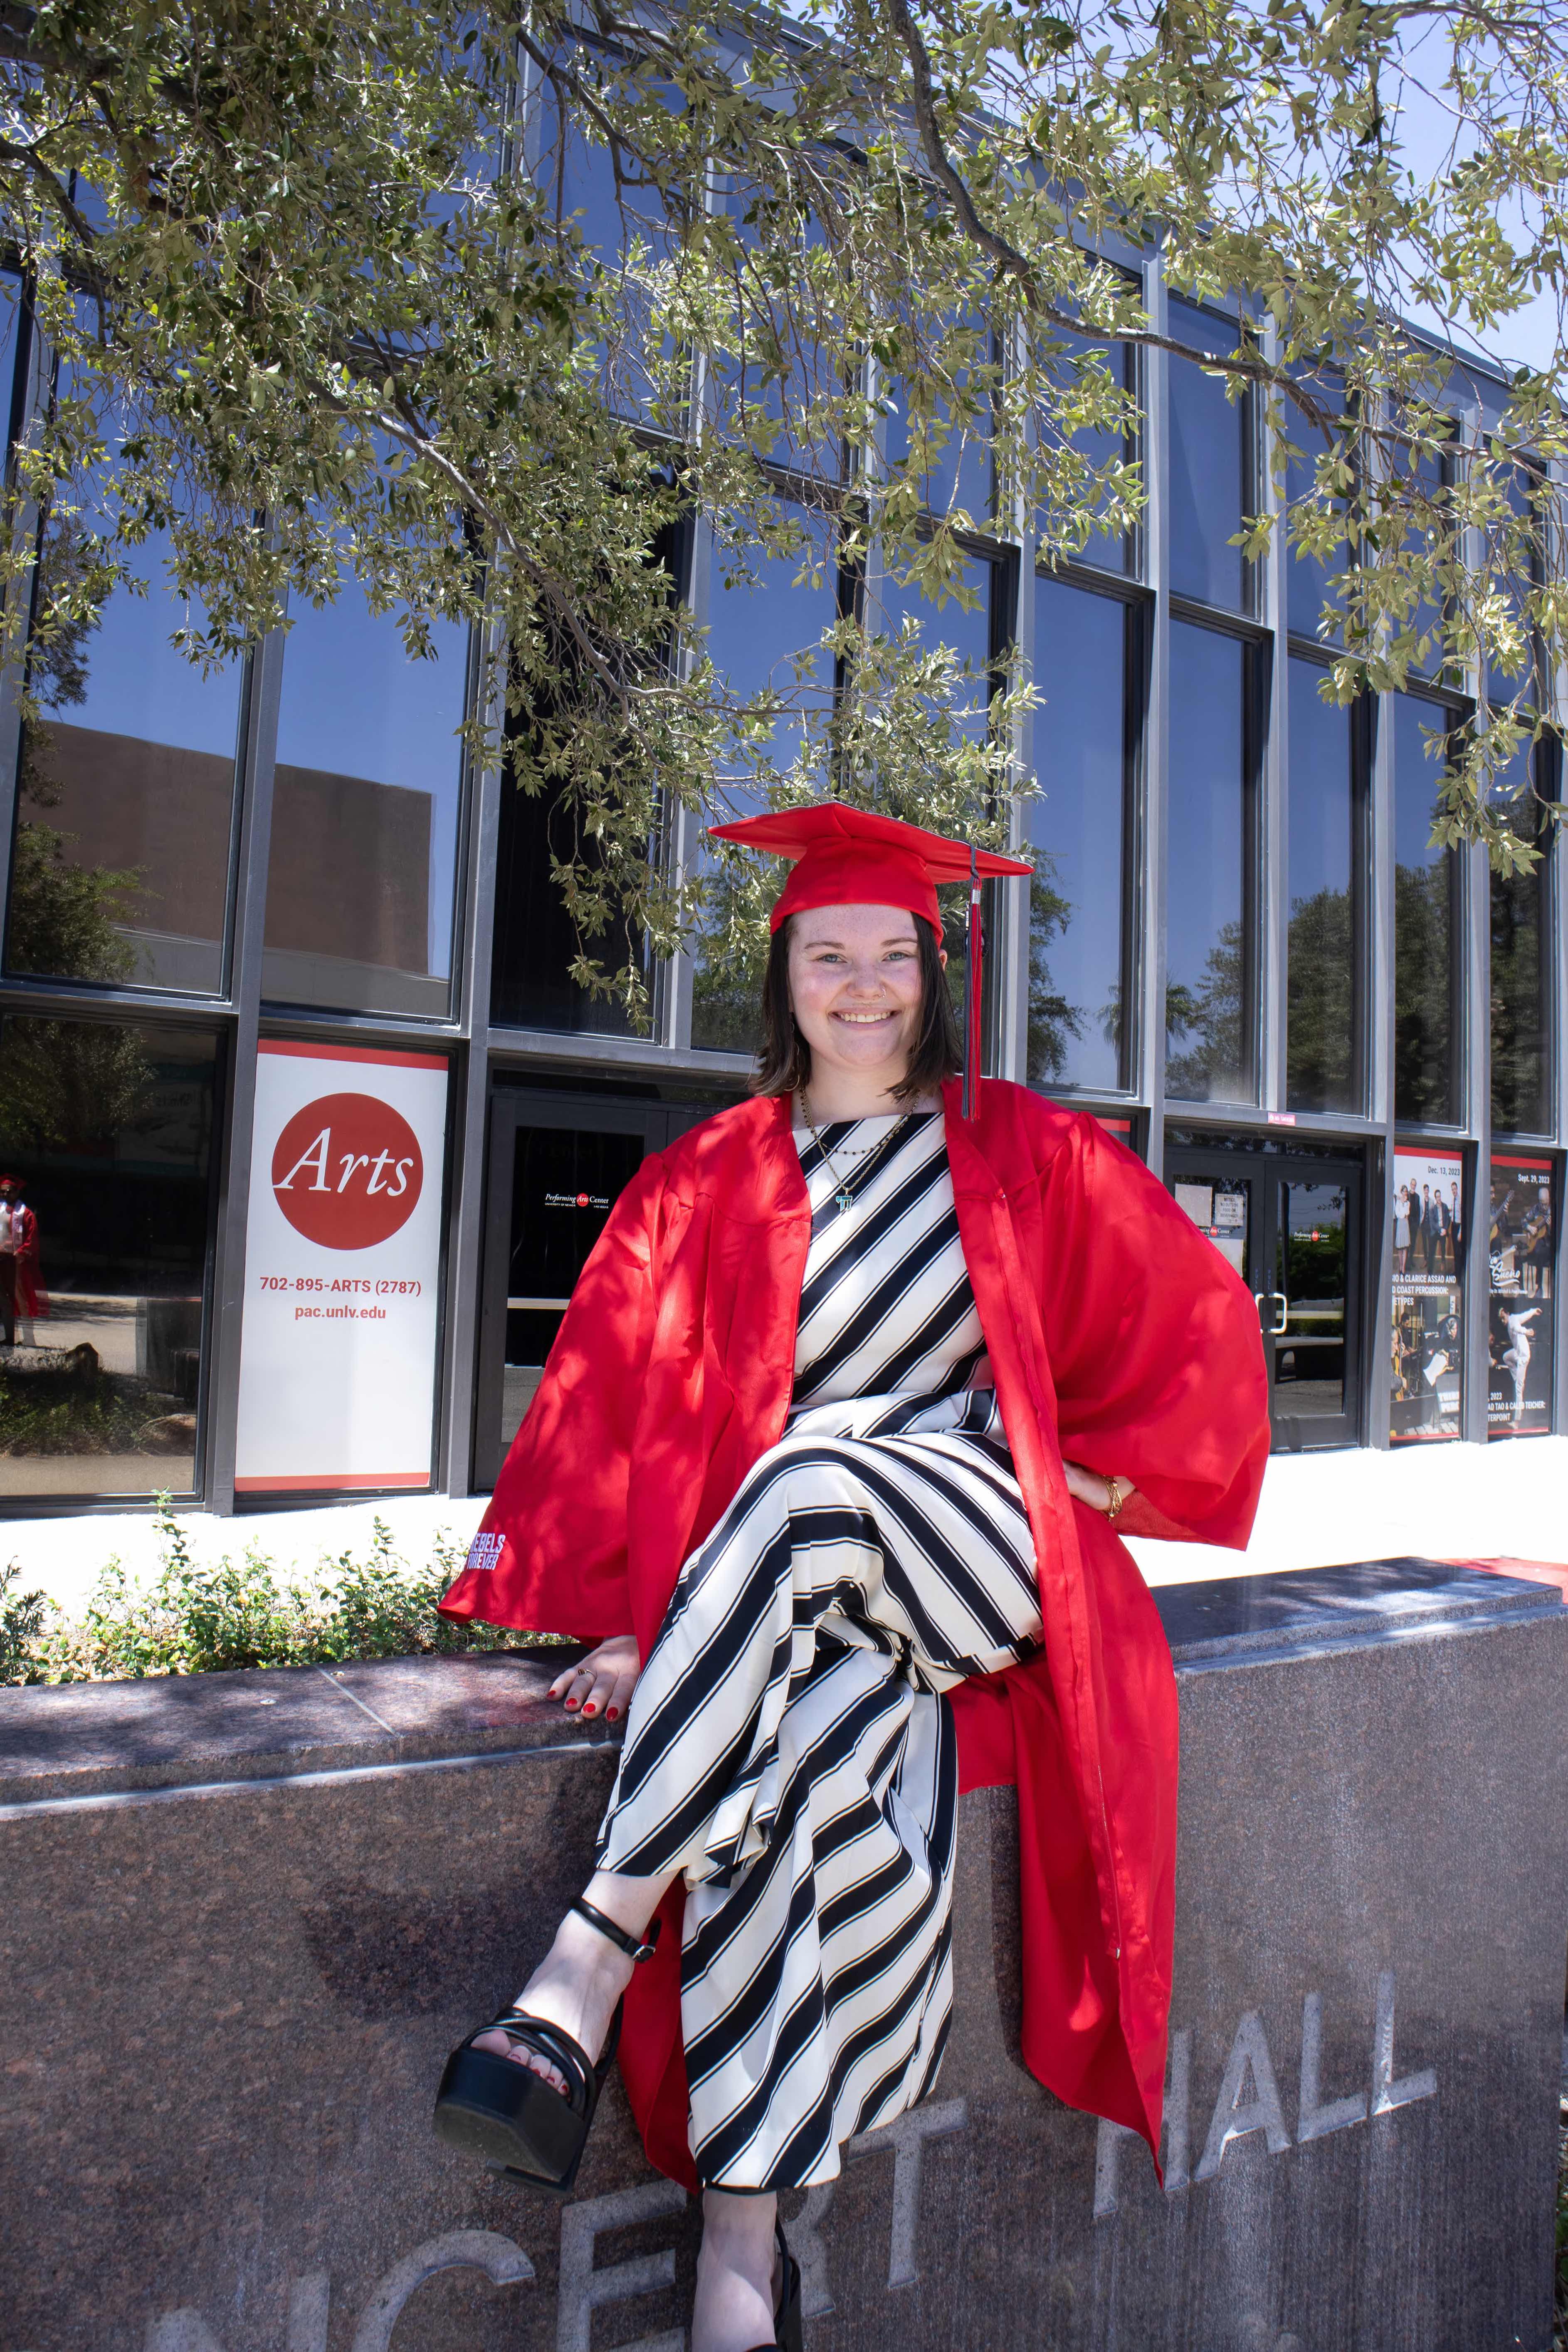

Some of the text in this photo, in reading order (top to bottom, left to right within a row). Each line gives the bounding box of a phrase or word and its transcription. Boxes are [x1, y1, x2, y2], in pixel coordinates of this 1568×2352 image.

[273, 1127, 413, 1196] Arts
[1518, 1174, 1530, 1184] Sept.
[1538, 1176, 1550, 1184] 2023
[546, 1193, 576, 1203] Performing
[1405, 1275, 1427, 1283] CLARICE
[1427, 1275, 1445, 1283] ASSAD
[260, 1277, 421, 1297] 702-895-ARTS (2787)
[295, 1305, 386, 1320] pac.unlv.edu
[1490, 1392, 1502, 1400] 2023
[1495, 1402, 1504, 1411] TAO
[1525, 1401, 1546, 1409] TEICHER:
[1487, 1413, 1510, 1422] TERPOINT
[1094, 1969, 1437, 2217] HALL
